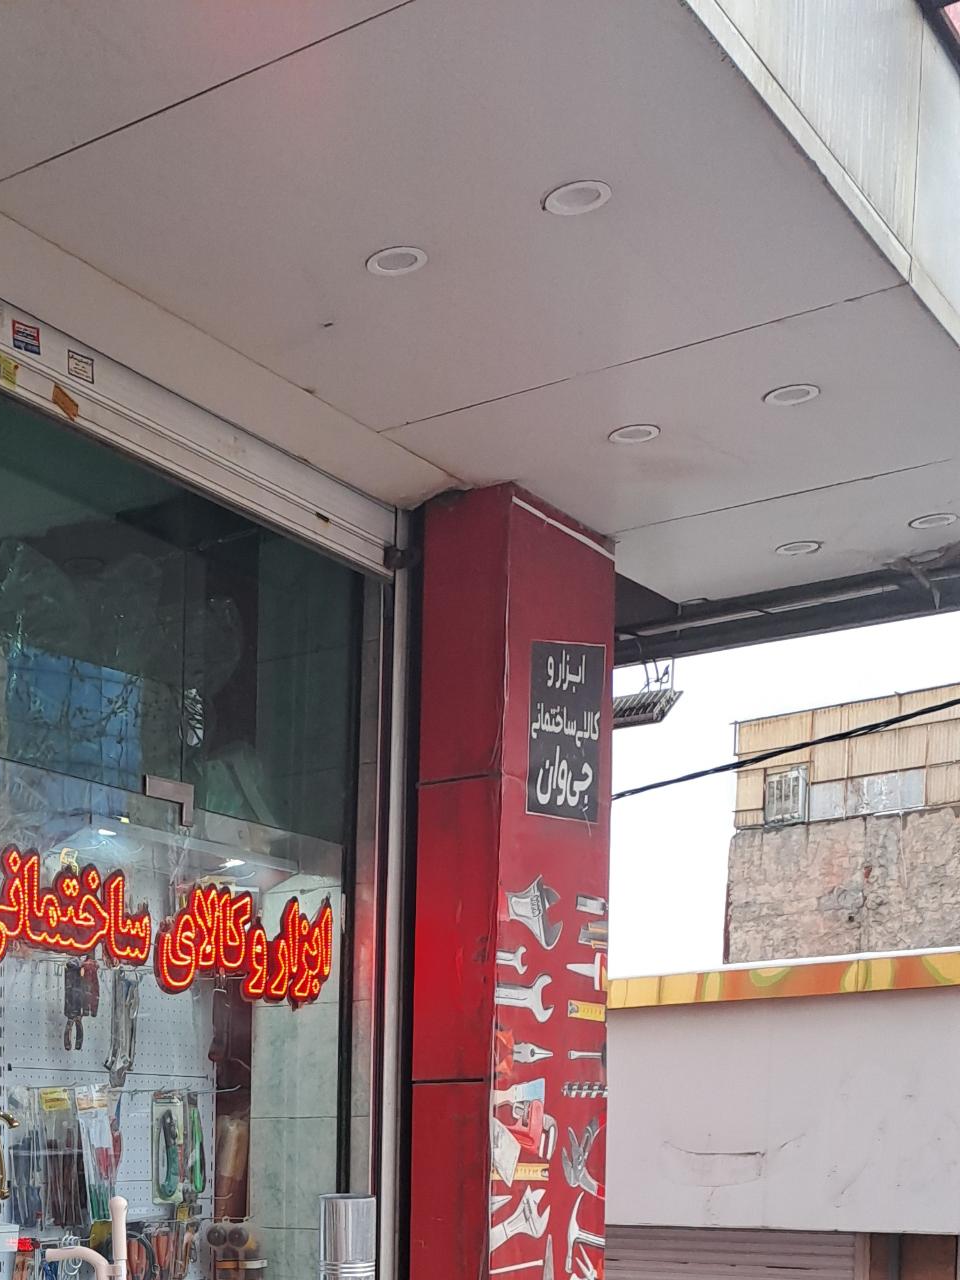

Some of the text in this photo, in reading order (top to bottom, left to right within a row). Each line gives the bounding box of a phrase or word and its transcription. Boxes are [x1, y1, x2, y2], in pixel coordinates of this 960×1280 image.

[555, 649, 586, 692] ابزار
[531, 702, 577, 739] ساختمانی
[155, 884, 252, 994] کالای
[266, 897, 333, 1002] ابزار
